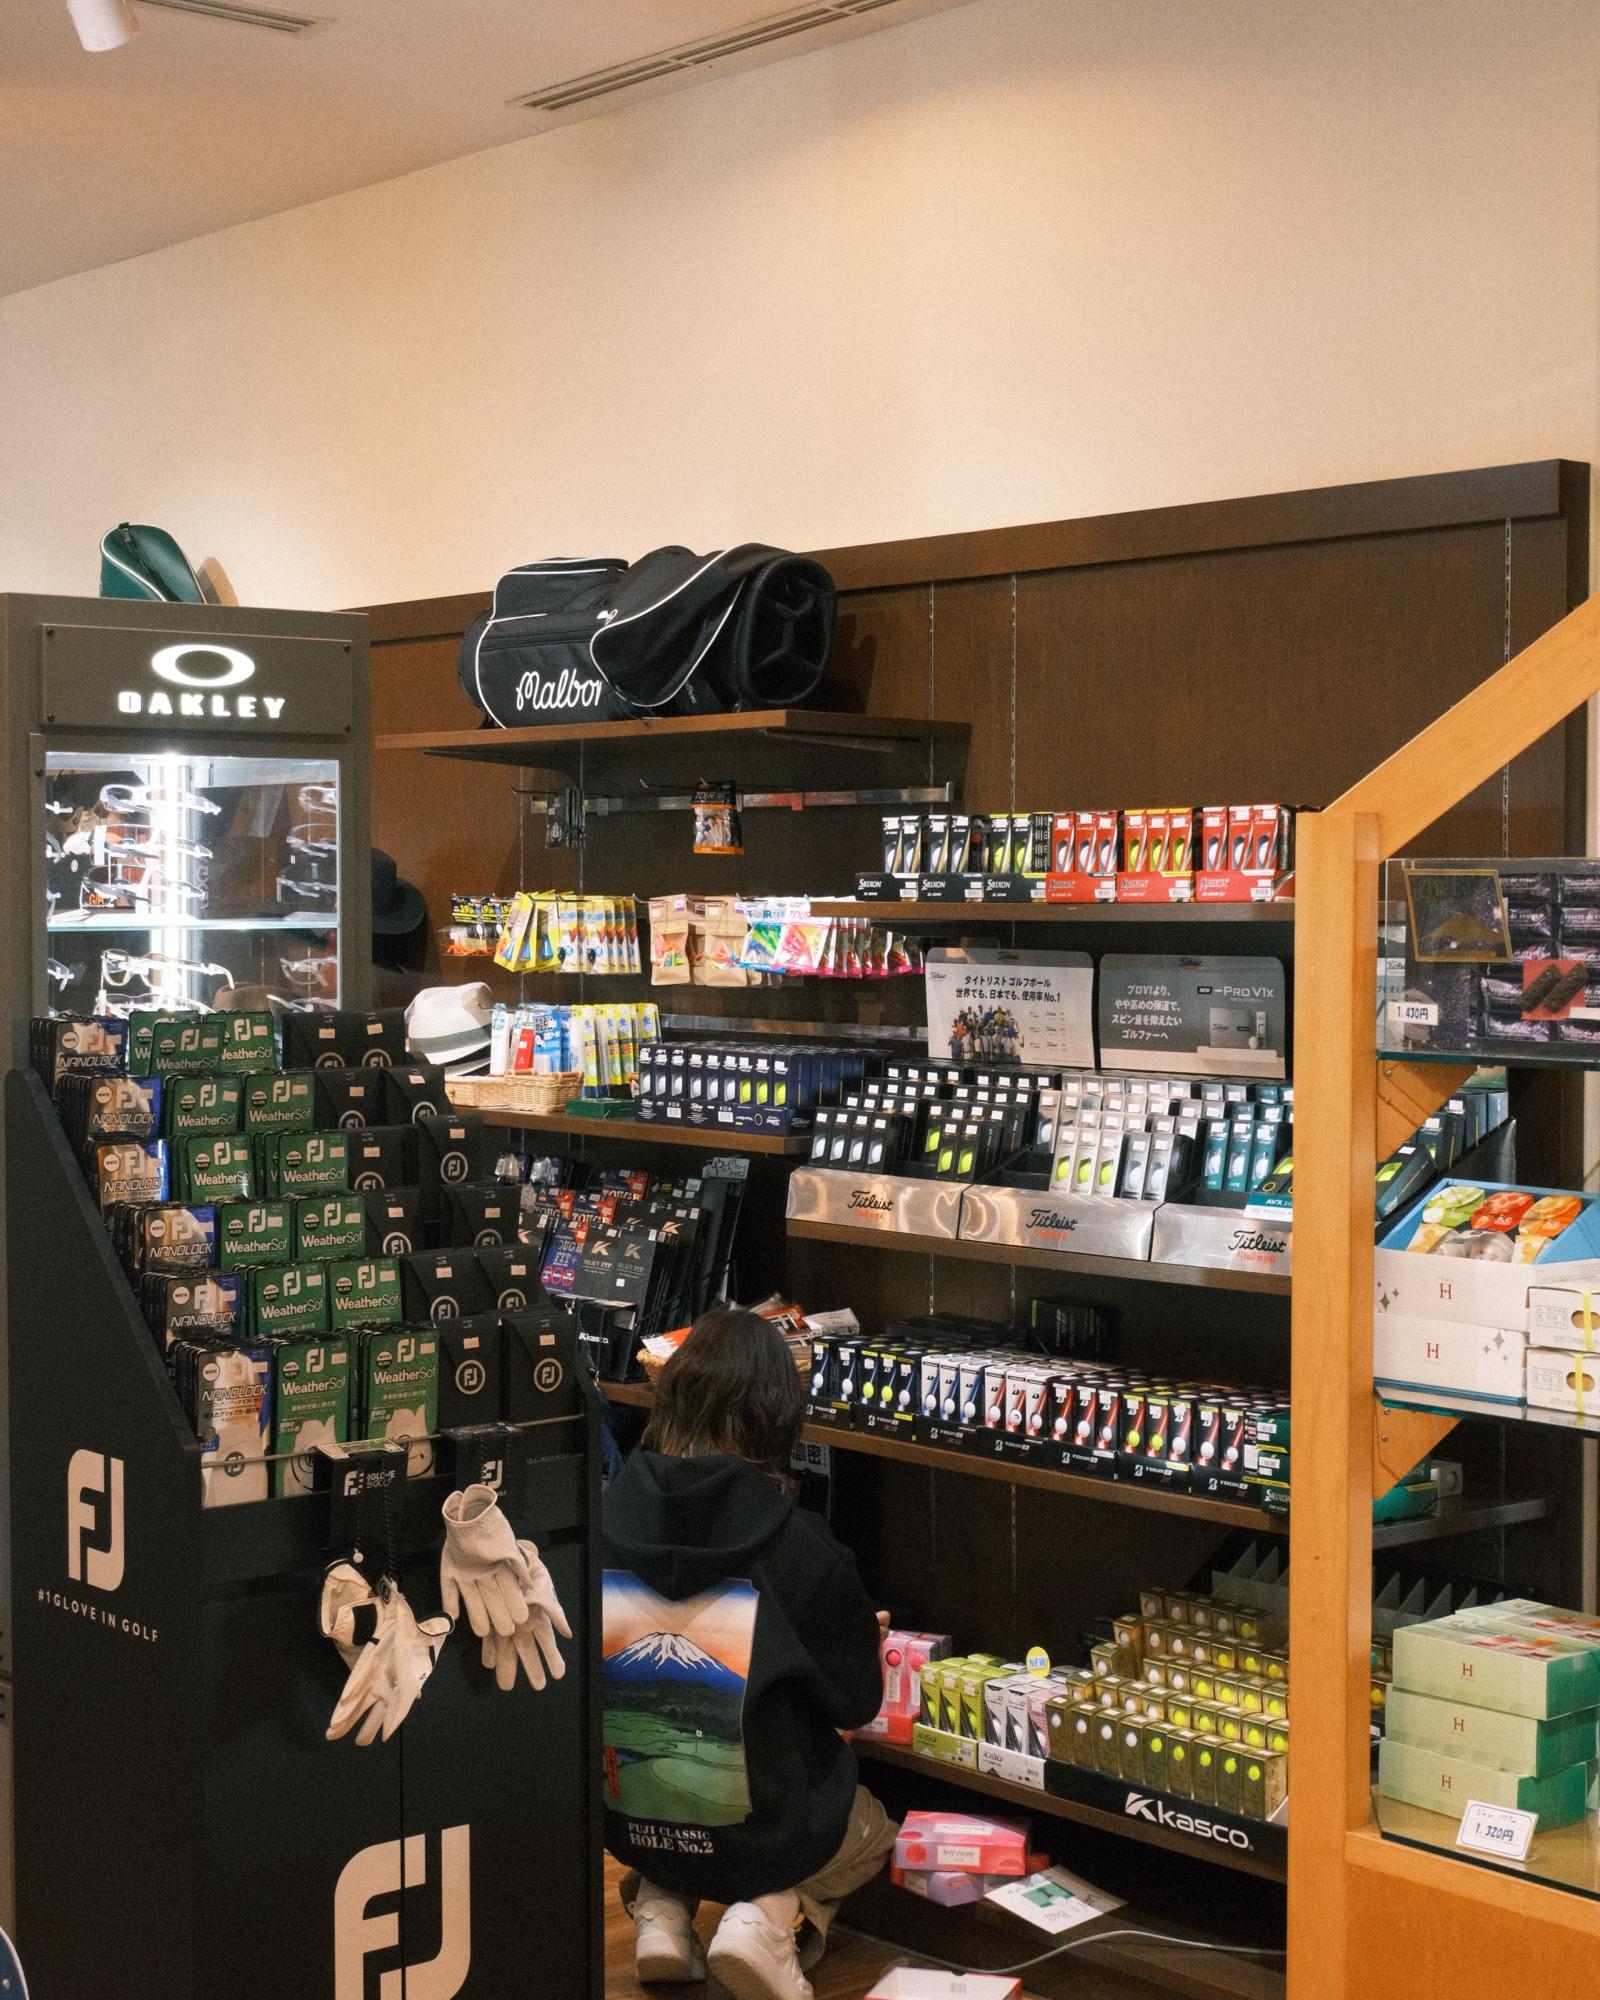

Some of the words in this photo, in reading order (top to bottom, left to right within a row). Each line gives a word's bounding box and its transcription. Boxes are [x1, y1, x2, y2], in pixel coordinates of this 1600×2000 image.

[118, 691, 286, 719] OAKLEY
[858, 878, 882, 891] SRIXON
[922, 878, 947, 891] SRIXON
[987, 878, 1011, 891] SRIXON
[965, 975, 1006, 987] タイトリスト
[1009, 976, 1051, 988] ゴルフボール
[181, 1029, 200, 1051] FJ
[234, 1018, 251, 1041] FJ
[1122, 1028, 1168, 1040] ゴルファーへ
[57, 1054, 122, 1068] NANOLOCK
[200, 1084, 216, 1108] FJ
[272, 1080, 290, 1103] FJ
[92, 1113, 156, 1126] NANOLOCK
[214, 1142, 230, 1166] FJ
[306, 1139, 324, 1163] FJ
[847, 1190, 894, 1211] Titleist
[248, 1208, 266, 1233] FJ
[324, 1202, 341, 1227] FJ
[1026, 1209, 1078, 1231] Titleist
[150, 1241, 213, 1258] NANOLOCK
[1228, 1230, 1287, 1253] Titleist
[283, 1271, 301, 1297] FJ
[357, 1265, 375, 1290] FJ
[1440, 1283, 1452, 1300] H
[170, 1311, 236, 1328] NANOLOCK
[306, 1348, 325, 1374] FJ
[397, 1338, 415, 1363] FJ
[1426, 1342, 1440, 1360] H
[463, 1369, 478, 1387] FJ
[541, 1367, 556, 1384] FJ
[202, 1383, 267, 1402] NANOLOCK
[68, 1448, 124, 1592] FJ
[53, 1593, 97, 1620] GLOVE
[102, 1610, 116, 1628] IN
[122, 1618, 159, 1643] GOLF
[1028, 1658, 1047, 1668] NEW
[1462, 1662, 1474, 1677] H
[1453, 1717, 1464, 1732] H
[1441, 1774, 1452, 1789] H
[628, 1822, 656, 1834] FUJI
[659, 1826, 710, 1841] CLASSIC
[629, 1832, 675, 1851] HOLE
[677, 1839, 714, 1854] No.2
[335, 1824, 470, 2000] FJ
